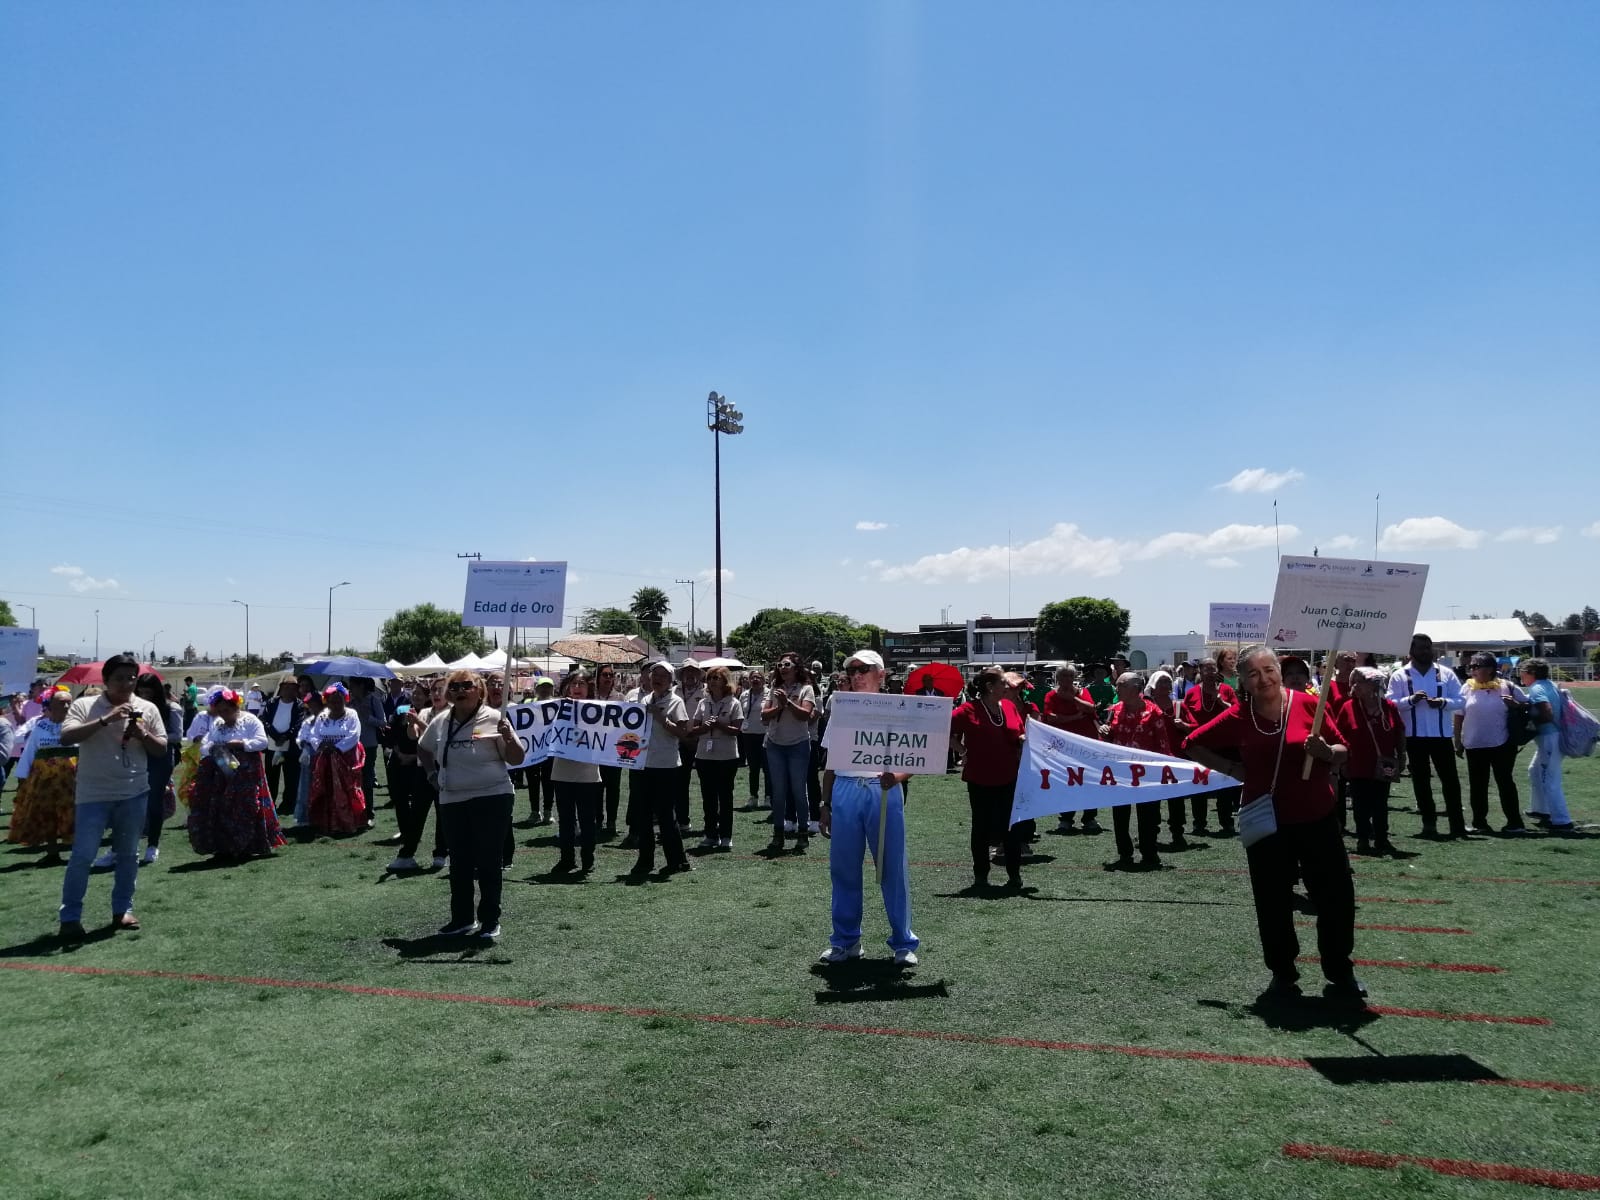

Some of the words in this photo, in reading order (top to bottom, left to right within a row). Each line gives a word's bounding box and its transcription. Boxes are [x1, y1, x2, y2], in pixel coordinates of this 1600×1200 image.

[474, 601, 507, 613] Edad
[510, 601, 527, 613] de
[531, 602, 554, 614] Oro
[1301, 605, 1328, 616] Juan
[1330, 607, 1341, 616] C.
[1345, 607, 1388, 619] Galindo
[1317, 619, 1366, 632] (Necaxa)
[1214, 629, 1265, 639] Texmelucan
[541, 699, 573, 726] DE
[580, 702, 645, 730] ORO
[854, 730, 928, 749] INAPAM
[851, 750, 926, 767] Zacatlán
[1039, 764, 1211, 790] INAPAM
